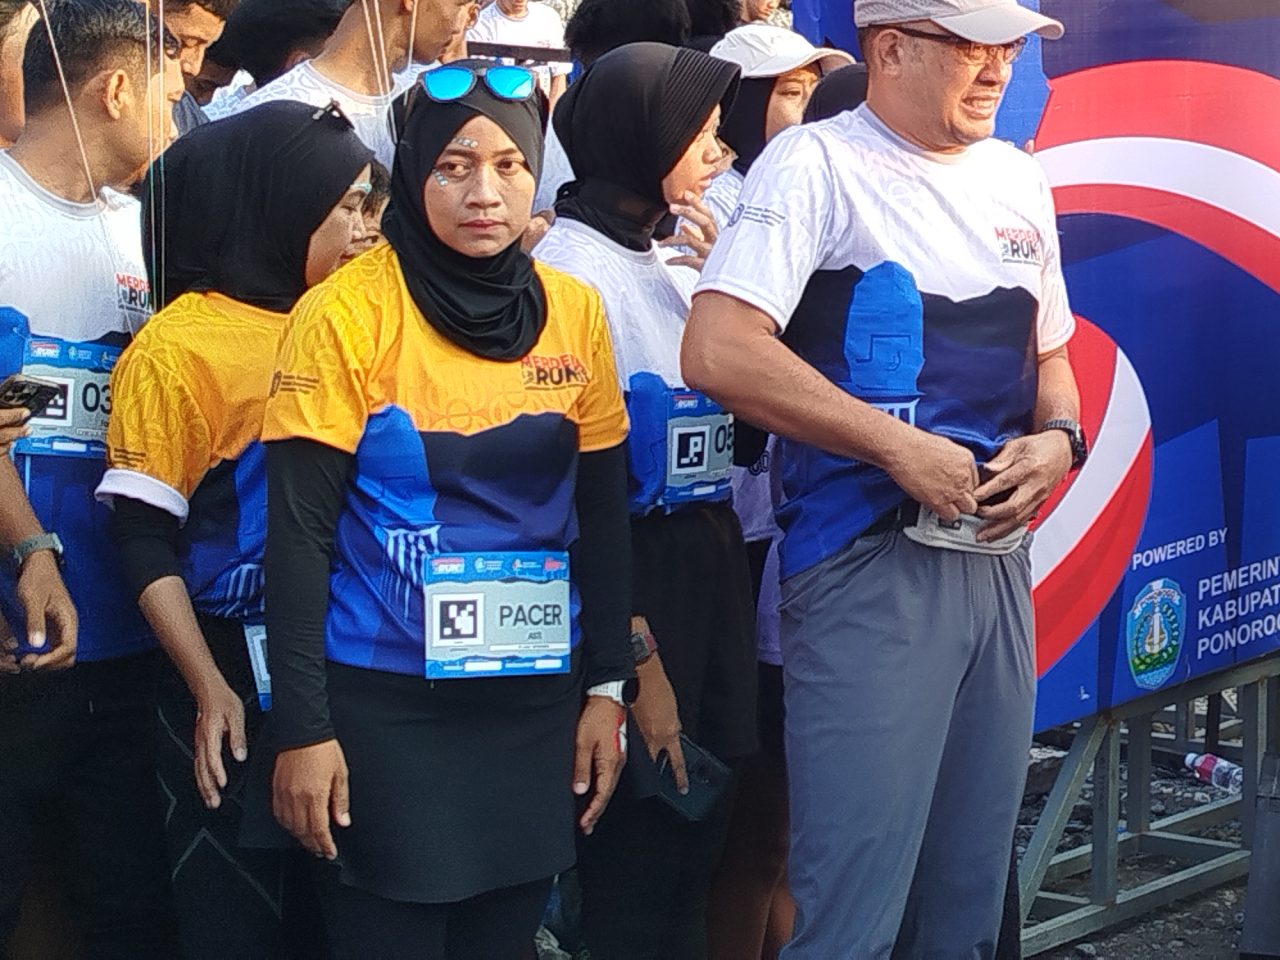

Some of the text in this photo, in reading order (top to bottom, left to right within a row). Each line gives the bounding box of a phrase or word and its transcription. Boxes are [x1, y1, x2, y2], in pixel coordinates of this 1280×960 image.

[1132, 527, 1229, 571] POWERED BY
[499, 603, 563, 627] PACER
